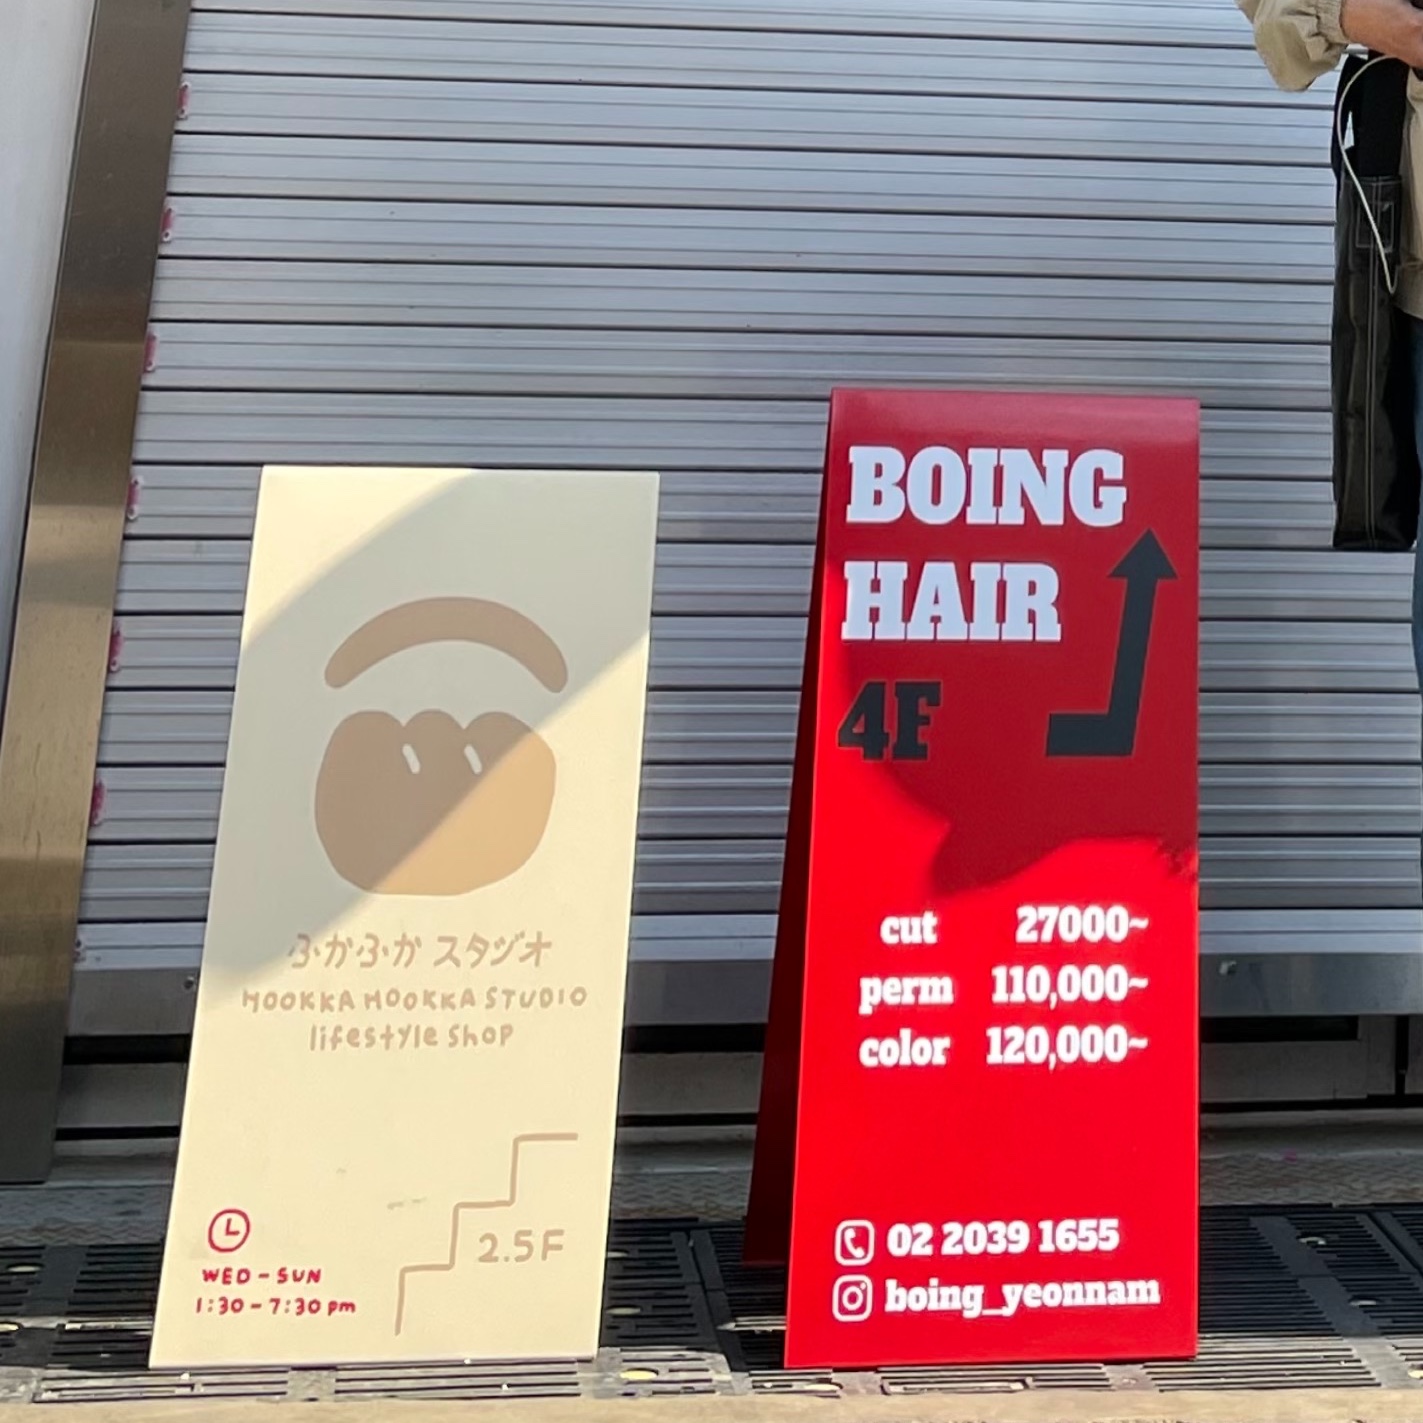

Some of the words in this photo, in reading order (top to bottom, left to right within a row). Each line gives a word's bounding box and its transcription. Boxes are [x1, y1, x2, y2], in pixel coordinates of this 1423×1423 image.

[847, 446, 1126, 526] BOING
[842, 561, 1061, 641] HAIR
[838, 682, 940, 759] 4F
[881, 912, 937, 944] cut
[288, 932, 421, 969] ふかふか
[434, 931, 552, 968] スタジオ
[242, 989, 355, 1013] HOOKKA
[364, 988, 475, 1010] HOOKKA
[485, 986, 587, 1010] STUDIO
[859, 977, 953, 1014] perm
[992, 964, 1148, 1009] 110,000~
[310, 1024, 438, 1051] lifestyle
[860, 1028, 950, 1066] color
[987, 1024, 1148, 1069] 120,000~
[478, 1229, 564, 1263] 2.5F
[888, 1223, 933, 1256] 02
[942, 1221, 1030, 1254] 2039
[1039, 1219, 1119, 1252] 1655
[885, 1278, 1160, 1318] boing_yeonnam
